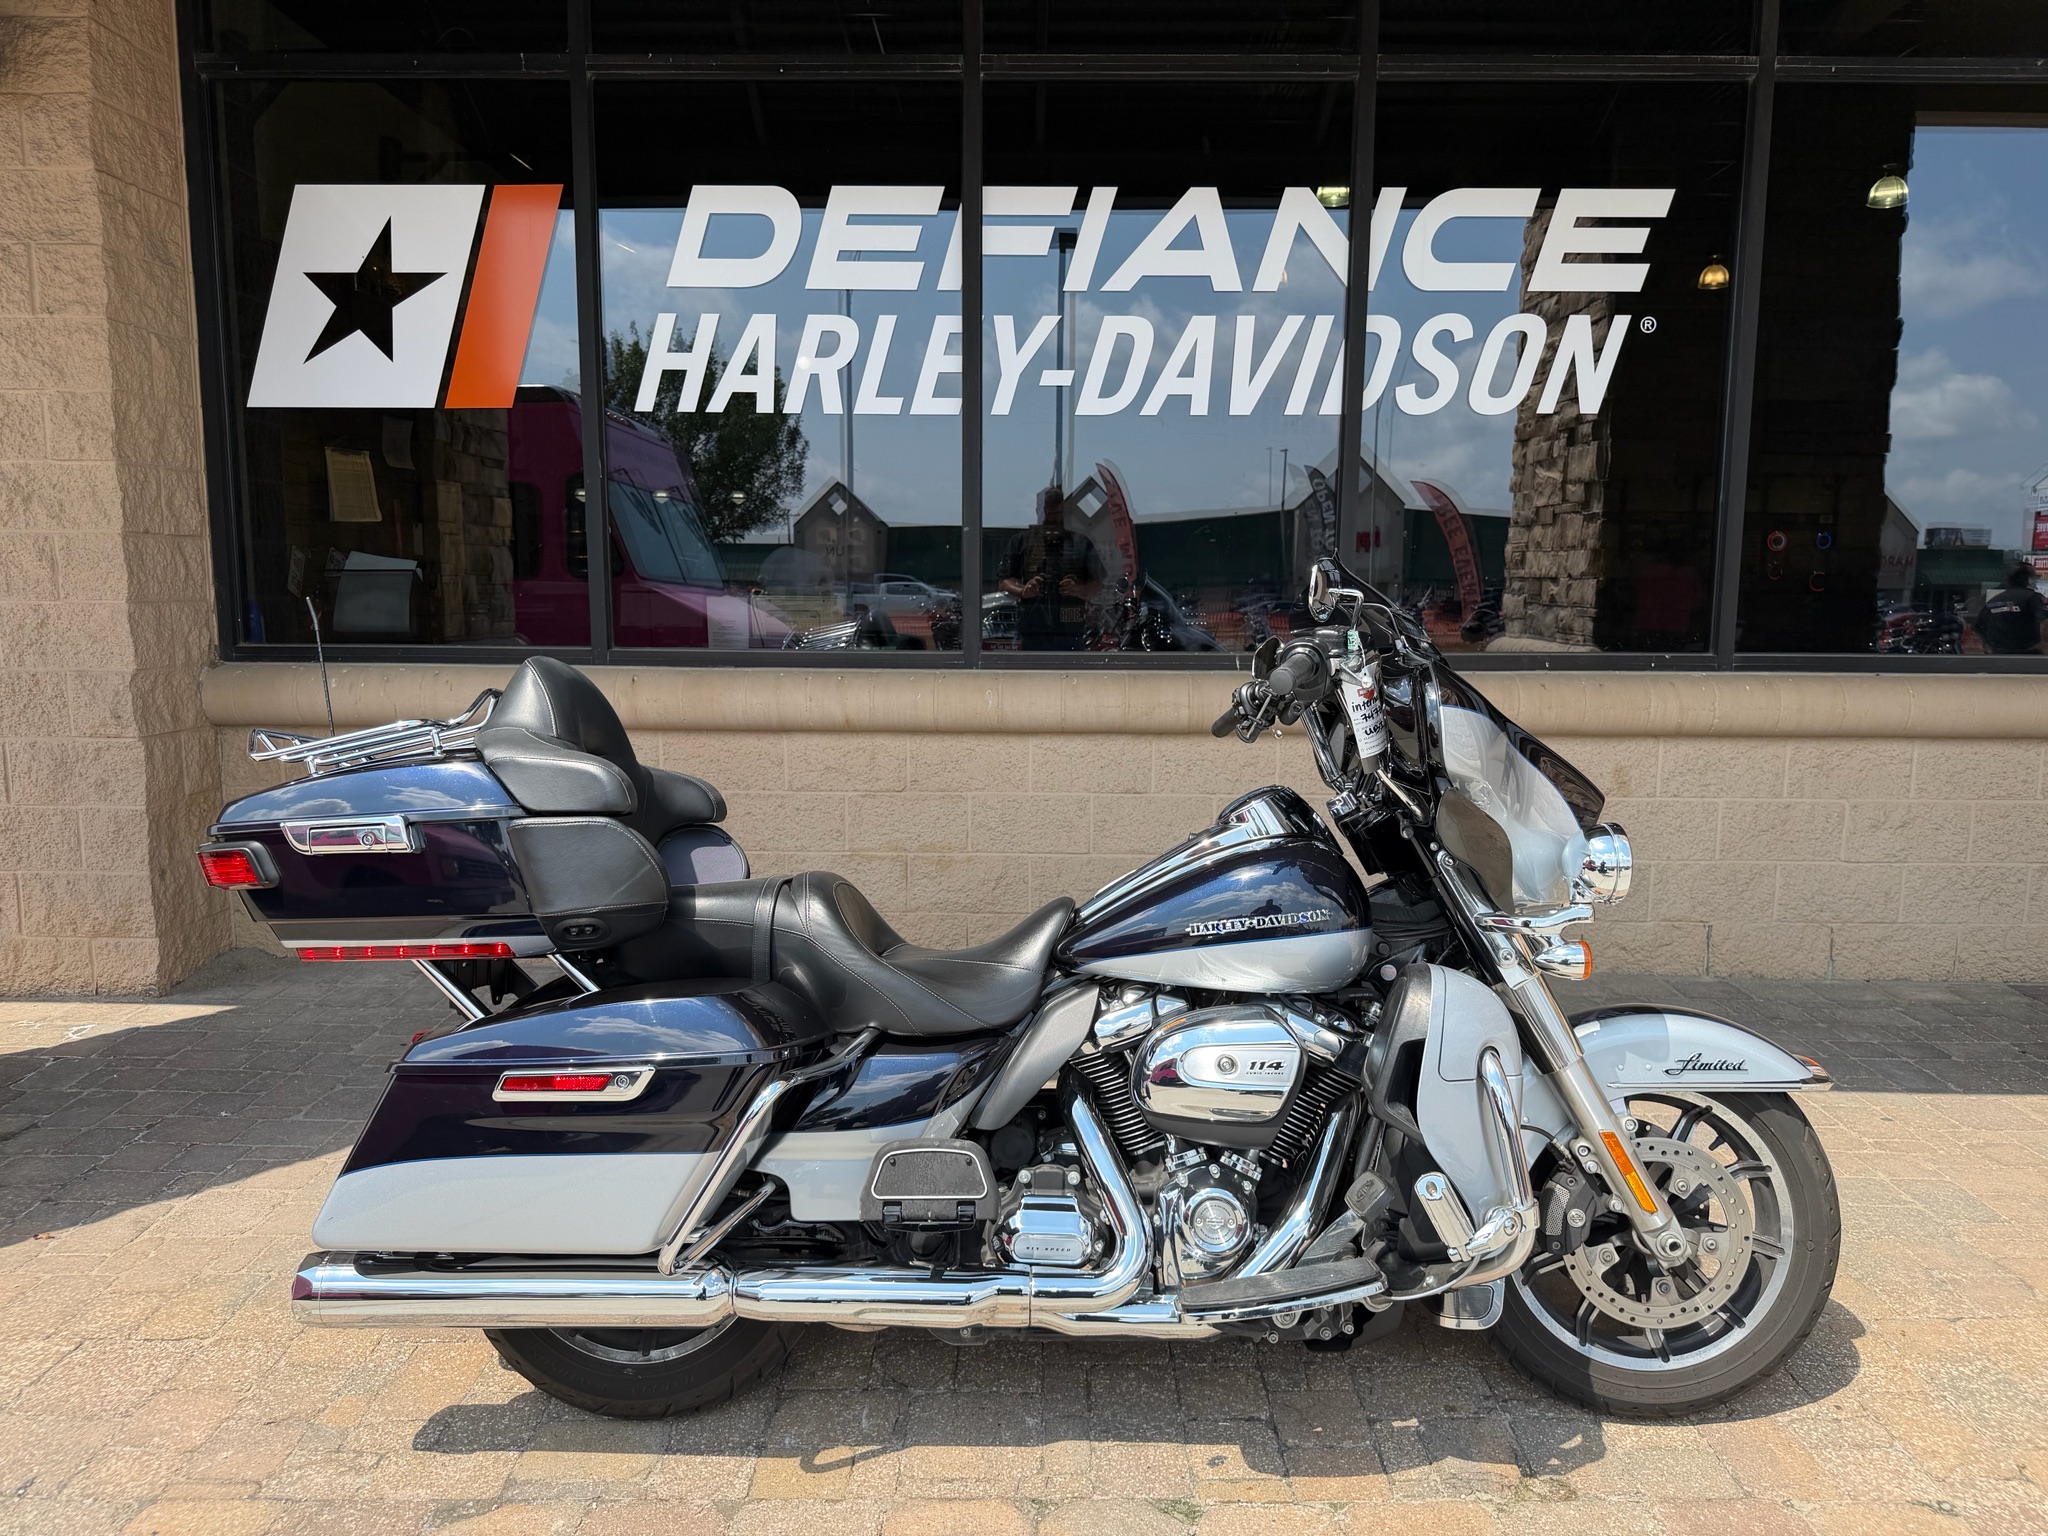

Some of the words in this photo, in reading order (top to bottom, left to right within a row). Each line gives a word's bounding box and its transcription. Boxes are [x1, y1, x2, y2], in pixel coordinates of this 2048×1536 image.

[667, 185, 1676, 292] DEFIANCE
[1249, 1061, 1285, 1071] 114
[1663, 1052, 1748, 1076] Limited
